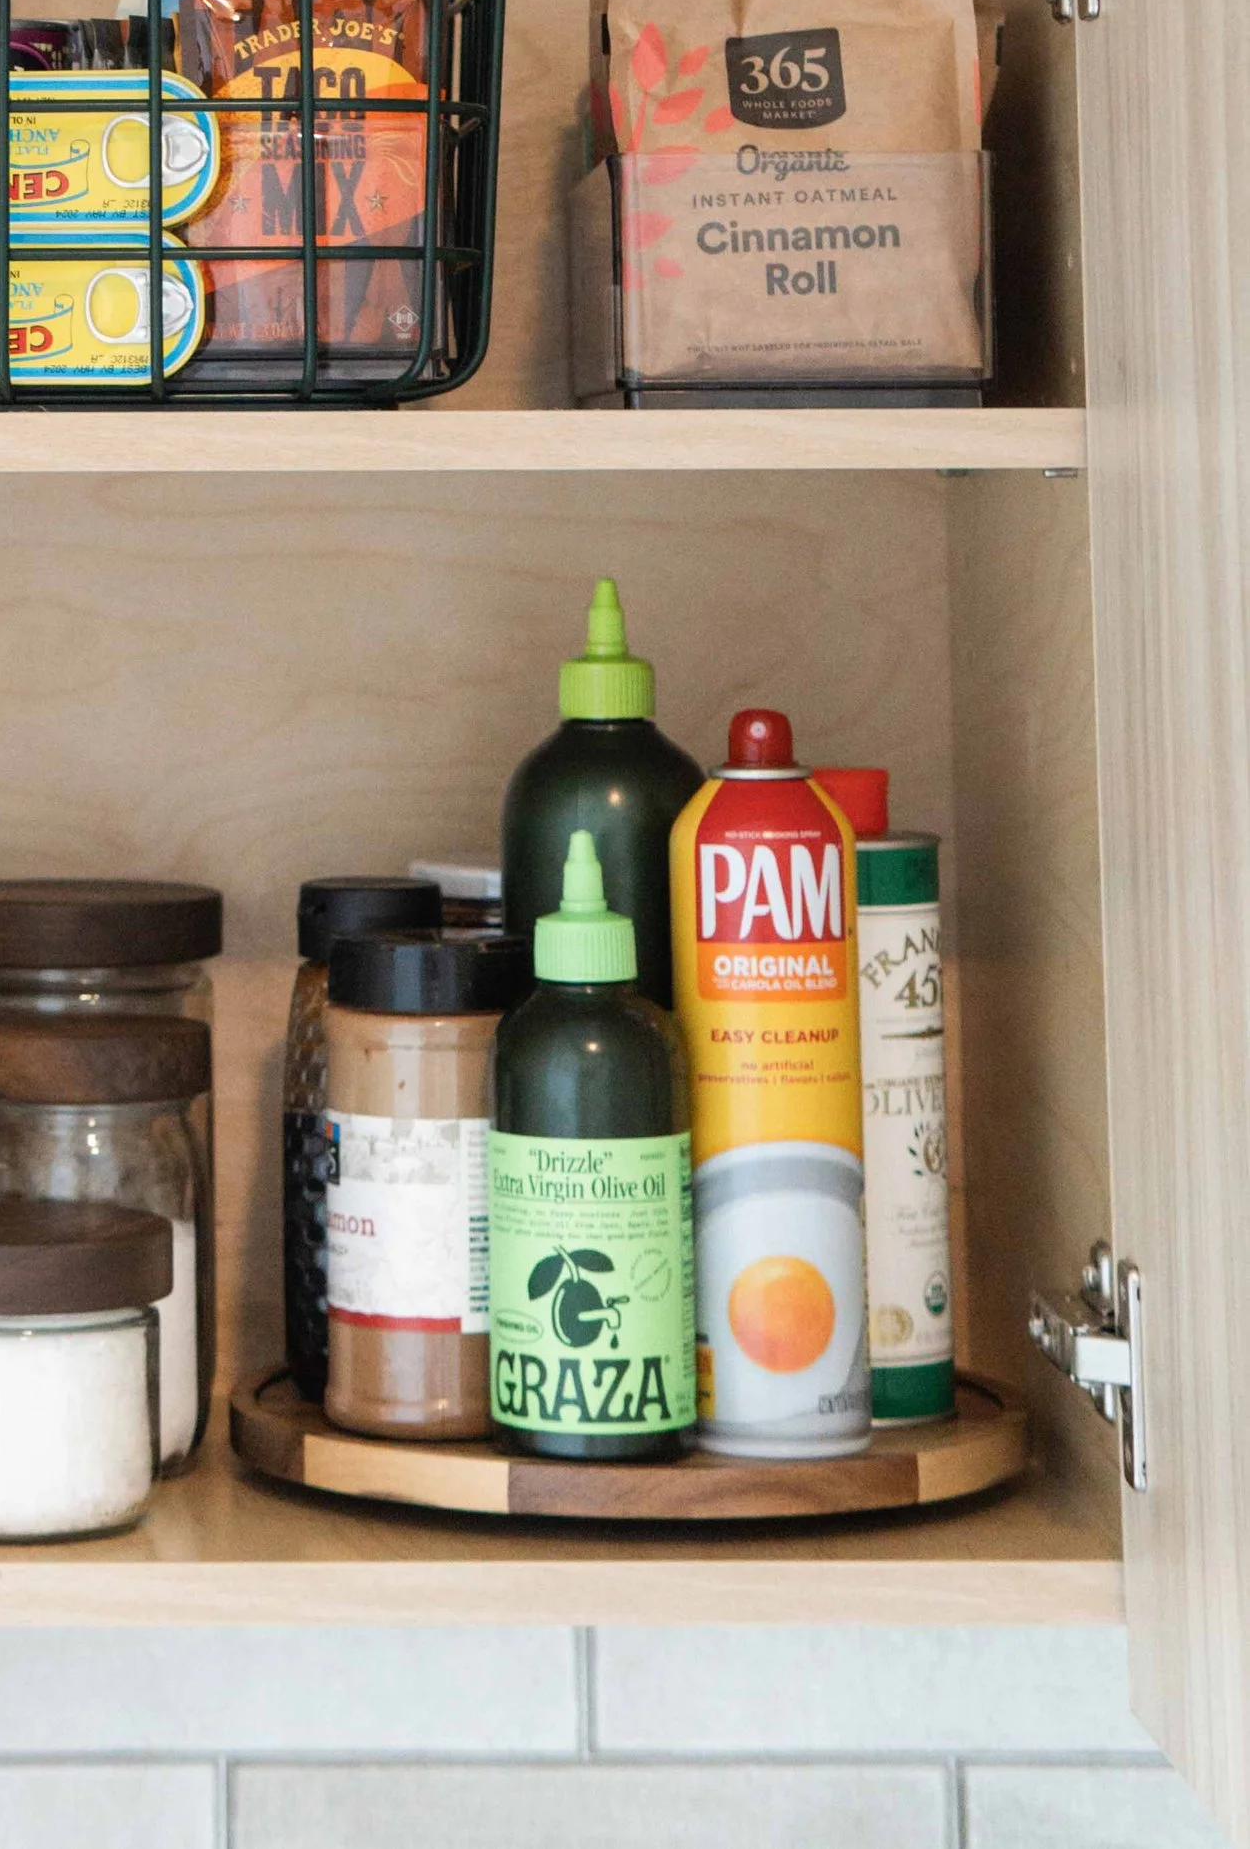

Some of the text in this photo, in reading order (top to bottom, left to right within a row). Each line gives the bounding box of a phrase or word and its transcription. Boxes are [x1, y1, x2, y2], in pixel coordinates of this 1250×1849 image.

[233, 18, 398, 60] TRADER JOE'S
[739, 46, 830, 95] 365
[253, 66, 367, 127] TACO
[742, 97, 832, 110] WHOLE FOODS
[26, 116, 37, 125] IN
[763, 110, 813, 120] MARKET
[261, 133, 366, 160] SEASNING
[736, 144, 850, 182] Organic
[261, 161, 368, 236] MIX
[692, 187, 898, 210] INSTANT OATMEAL
[696, 220, 901, 255] Cinnamon
[765, 260, 838, 296] Roll
[752, 344, 791, 352] LABELED
[700, 843, 842, 940] PAM
[713, 954, 834, 977] ORIGINAL
[731, 978, 781, 991] CANOLA
[783, 979, 801, 990] OIL
[804, 977, 838, 990] BLEND
[711, 1028, 840, 1044] EASY CLEANUP
[741, 1059, 815, 1071] no artificial
[493, 1168, 666, 1204] Extra Virgin Olive Oil
[496, 1350, 672, 1423] GRAZA
